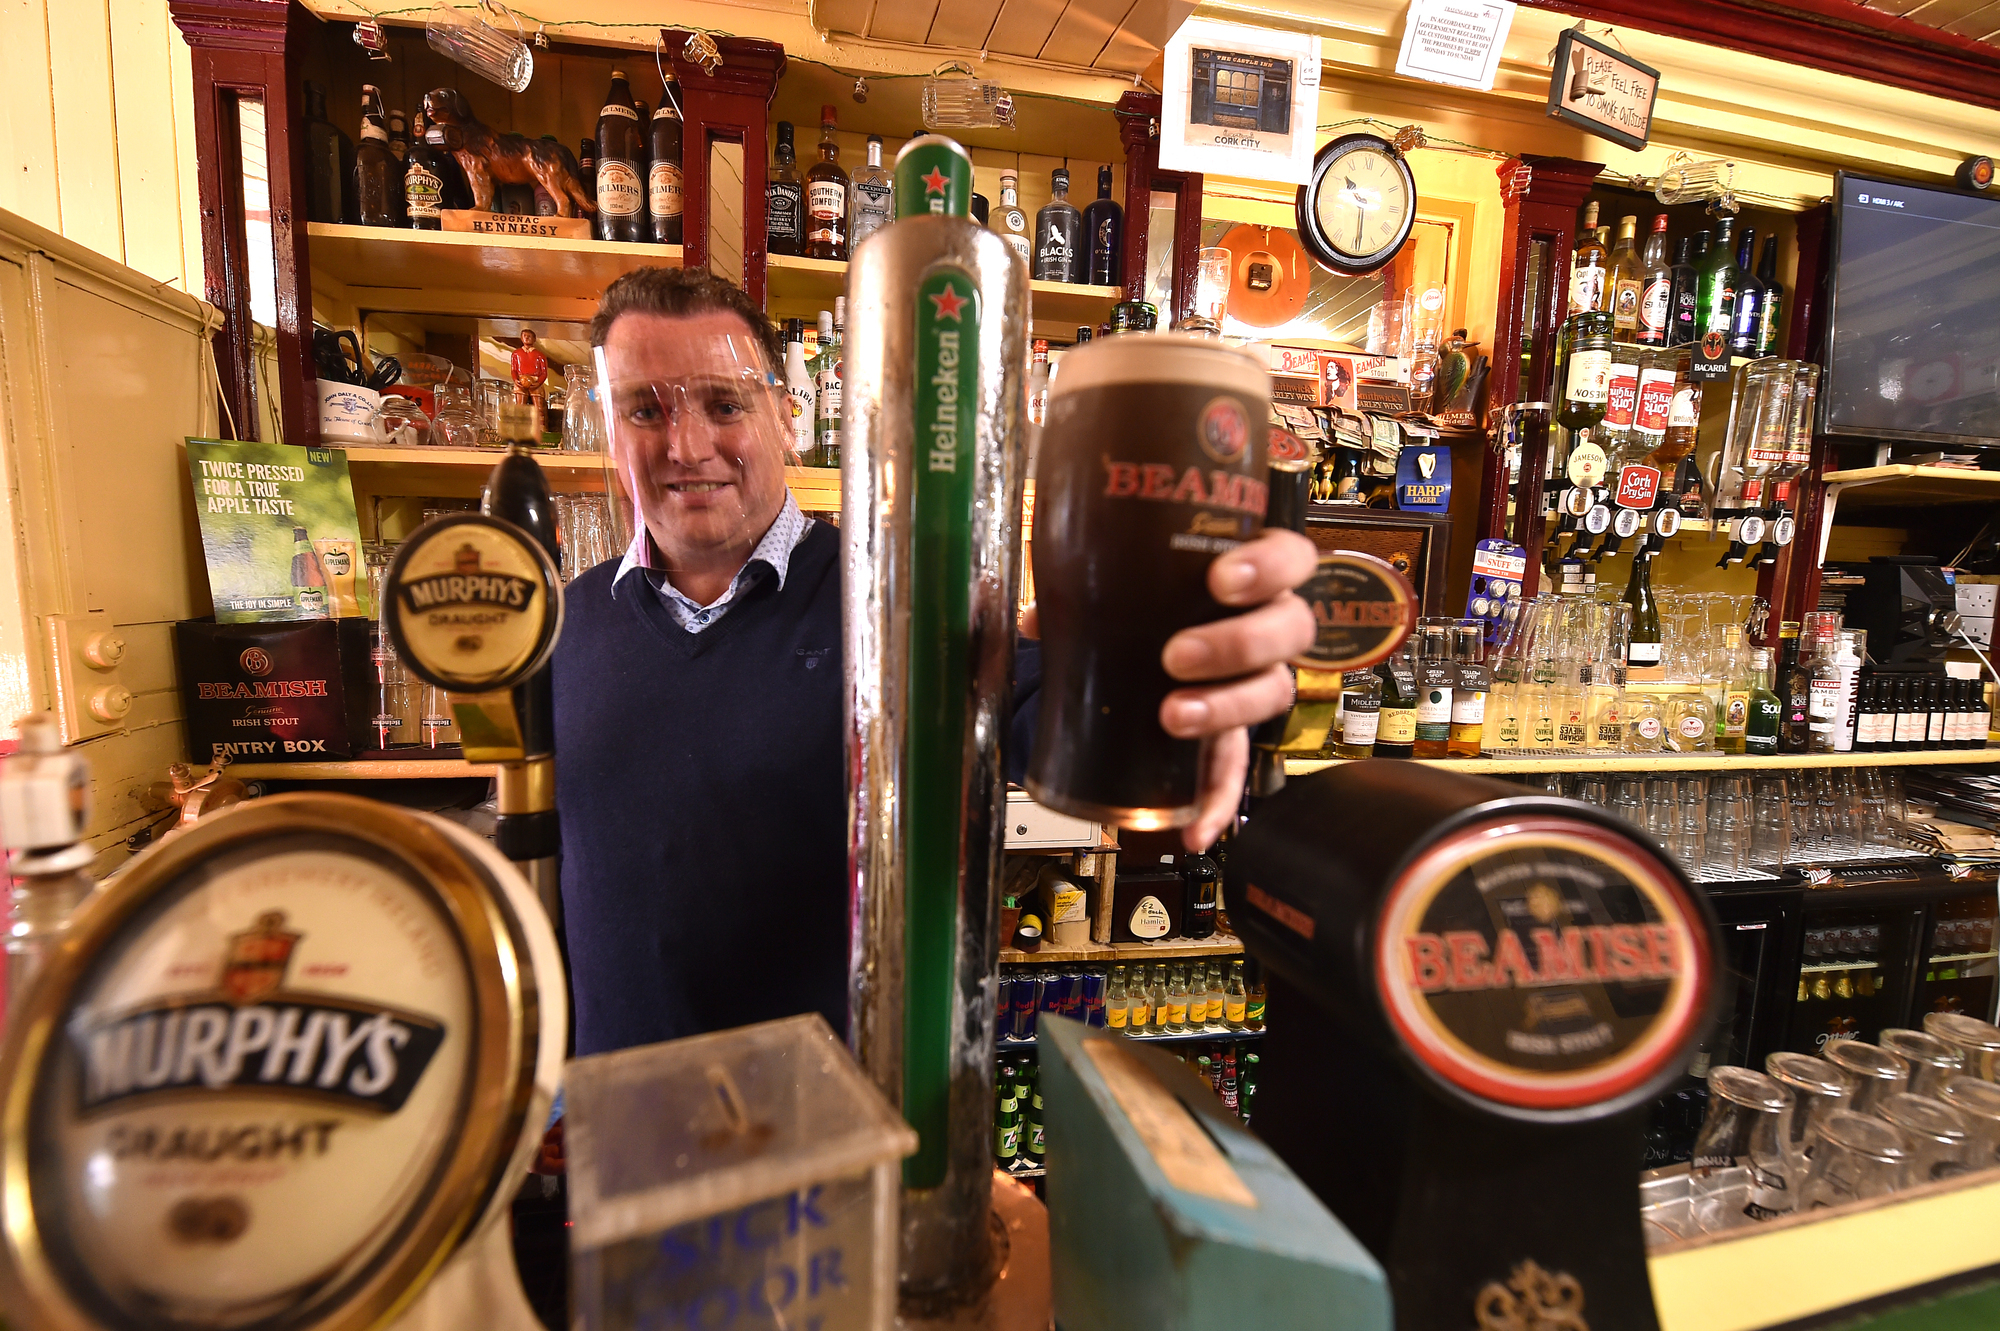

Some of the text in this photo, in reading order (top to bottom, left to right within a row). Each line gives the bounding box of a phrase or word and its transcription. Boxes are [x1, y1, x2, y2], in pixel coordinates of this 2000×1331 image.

[1420, 22, 1491, 42] GOVERNMENT REGULATIONS
[1437, 18, 1471, 30] ACCORDANCE
[1472, 25, 1486, 33] WITH
[1427, 32, 1457, 43] CUSTOMERS
[1424, 46, 1446, 56] MONDAY
[1454, 52, 1474, 61] SUNDAY
[1233, 56, 1258, 66] CASTLE
[1260, 60, 1273, 68] INN
[1586, 56, 1612, 75] PLEASE
[1611, 73, 1648, 100] FEEL FREE
[1597, 95, 1618, 120] SMOKE
[1619, 107, 1648, 130] OUTSIDE
[1214, 135, 1238, 146] CORK
[1241, 138, 1261, 148] CITY
[598, 183, 639, 196] BULMERS
[810, 187, 842, 199] SOUTHERN
[811, 198, 841, 207] COMFORT
[492, 214, 539, 224] COGNAC
[473, 221, 558, 236] HENNESSY
[1040, 247, 1074, 258] BLACKS
[1355, 356, 1386, 374] EAMISH
[1694, 363, 1728, 373] BACARDÍ
[1370, 370, 1388, 378] STOUT
[825, 381, 843, 390] BAC
[1271, 380, 1316, 395] mithwick's
[325, 393, 337, 403] JOHN
[792, 387, 814, 407] LIBU
[929, 330, 960, 474] Heineken
[1270, 391, 1317, 402] ARLEY WINE
[1357, 391, 1403, 405] Smithwick's
[1382, 402, 1404, 411] WINE
[1611, 397, 1635, 412] Cork
[1644, 402, 1670, 417] Cork
[309, 451, 331, 463] NEW
[1574, 454, 1604, 463] JAMESON
[199, 460, 304, 482] TWICE PRESSED
[1628, 472, 1651, 488] Cork
[203, 478, 281, 498] FOR A TRUE
[1406, 485, 1445, 497] HARP
[207, 498, 294, 516] APPLE TASTE
[1487, 558, 1512, 569] SNUFF
[410, 576, 527, 608] MURPHY'S
[230, 598, 292, 610] THE JOY IN SIMPLE
[1311, 600, 1409, 627] AMISH
[795, 647, 831, 656] GANT
[198, 680, 327, 699] BEAMISH
[1351, 698, 1381, 706] MIDLETO
[1762, 704, 1781, 713] SOU
[232, 717, 299, 727] IRISH STOUT
[212, 739, 326, 755] ENTRY BOX
[1800, 868, 1831, 884] Miller
[1841, 869, 1878, 877] GENUINE
[1406, 922, 1680, 992] BEAMISH
[84, 1006, 411, 1100] MURPHY'S
[105, 1120, 341, 1164] DRAUGHT
